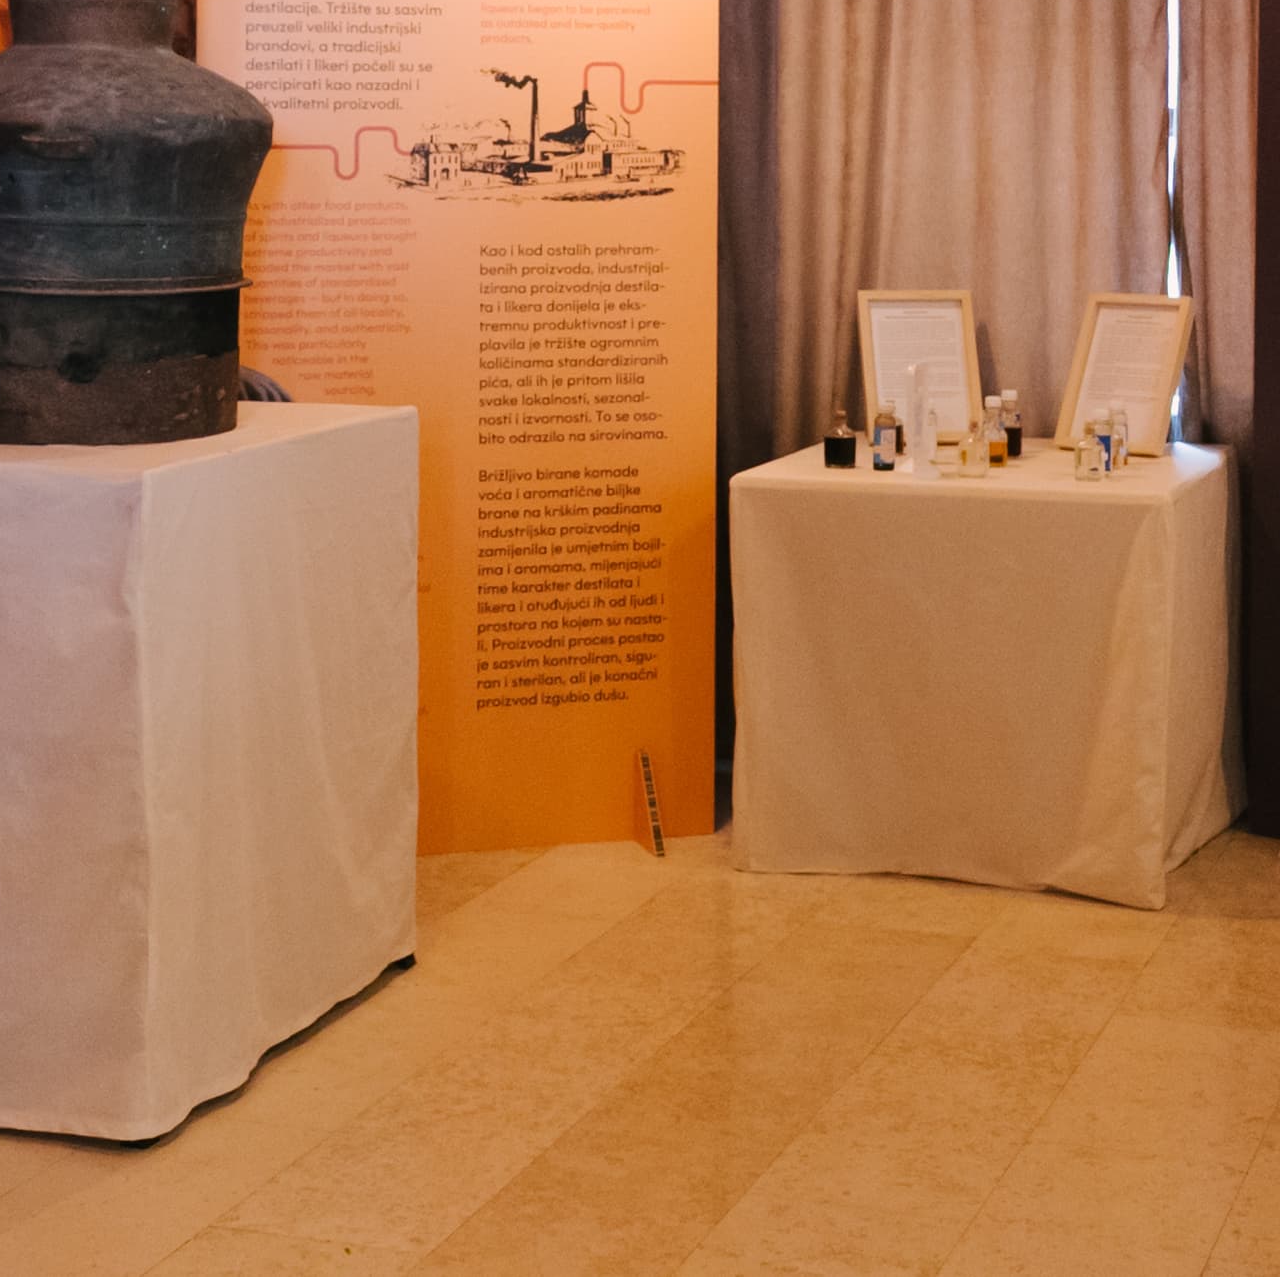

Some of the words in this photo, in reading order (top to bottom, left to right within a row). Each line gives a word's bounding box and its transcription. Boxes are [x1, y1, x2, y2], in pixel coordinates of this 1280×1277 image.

[479, 245, 508, 256] Kao
[510, 245, 515, 257] i
[517, 244, 544, 256] kod
[546, 244, 592, 256] ostalih
[594, 245, 659, 256] prehram-
[479, 263, 518, 275] benih
[520, 263, 594, 276] proizvoda,
[597, 262, 669, 274] industrijal-
[479, 284, 528, 294] izirana
[529, 282, 612, 294] proizvodnja
[614, 280, 665, 292] destila-
